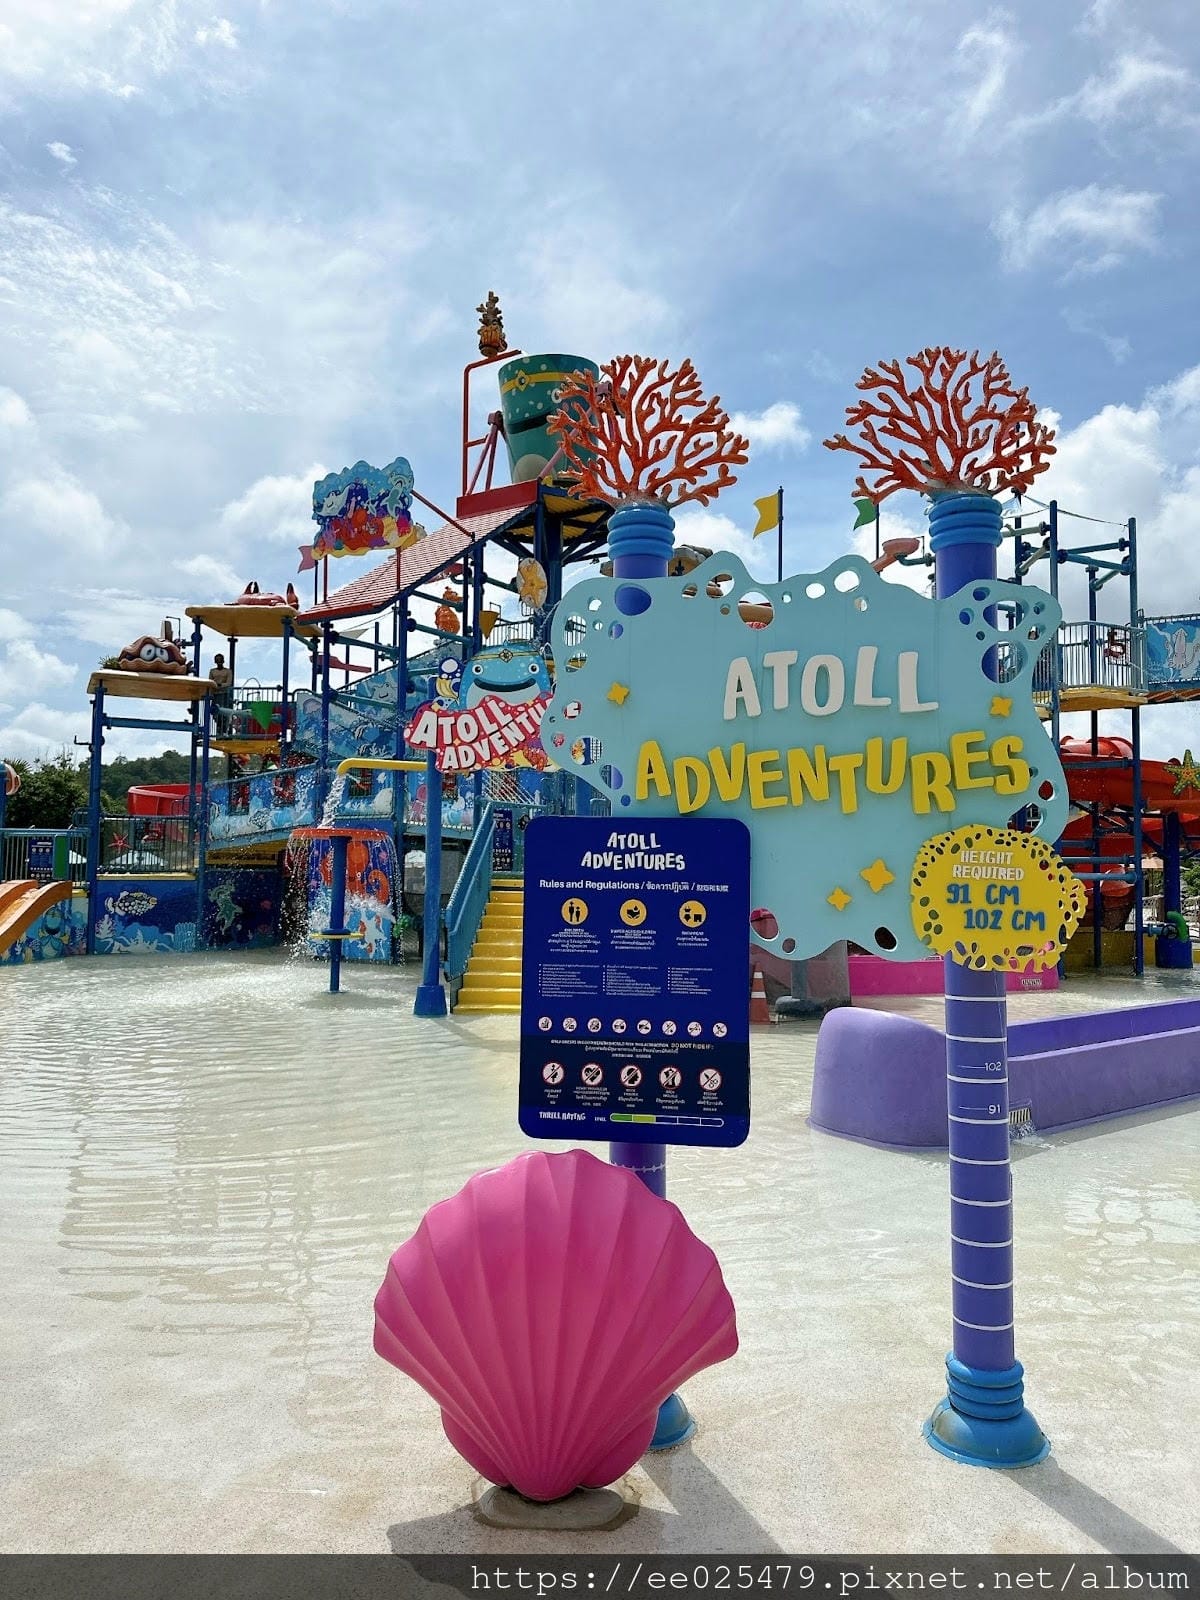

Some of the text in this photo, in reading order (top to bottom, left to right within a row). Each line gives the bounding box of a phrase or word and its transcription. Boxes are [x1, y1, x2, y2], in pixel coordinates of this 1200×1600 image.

[723, 646, 939, 720] ATOLL
[410, 699, 513, 748] ATOLL
[442, 699, 554, 769] ADVENTU
[635, 730, 1031, 814] ADVENTURES
[607, 832, 661, 850] ATOLL
[581, 851, 686, 871] ADVENTURES
[960, 850, 1013, 865] HEIGHT
[952, 865, 1025, 881] REQUIRED
[539, 879, 565, 889] Rules
[565, 880, 584, 889] and
[585, 880, 640, 891] Regulations
[946, 884, 1020, 905] 91 CM
[964, 909, 1046, 931] 102 CM
[985, 1062, 1002, 1072] 102
[988, 1104, 1001, 1115] 91
